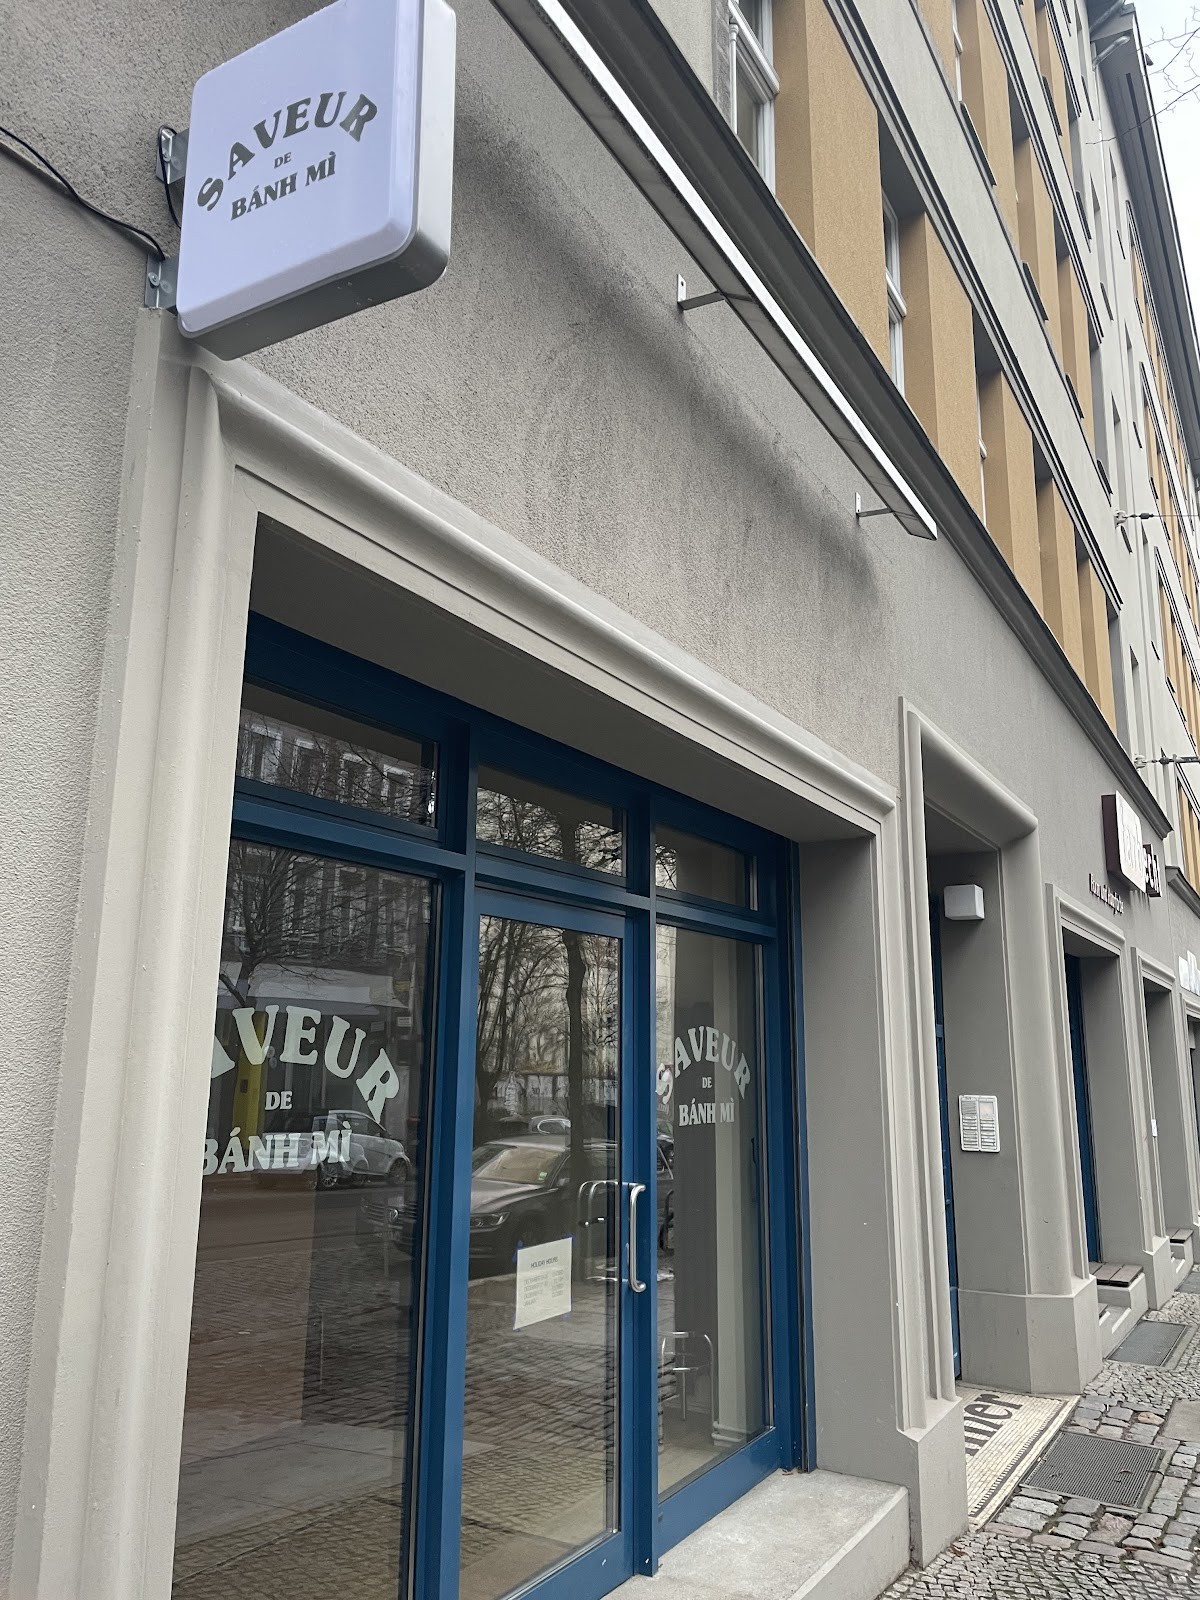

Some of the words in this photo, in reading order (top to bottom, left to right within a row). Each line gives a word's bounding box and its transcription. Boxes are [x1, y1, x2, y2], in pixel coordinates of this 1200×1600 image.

[197, 91, 377, 211] SAVEUR
[274, 152, 292, 169] DE
[230, 172, 298, 221] BÁNH
[305, 151, 336, 187] MÌ
[656, 1026, 751, 1104] SAVEUR
[702, 1077, 712, 1089] DE
[265, 1090, 293, 1110] DE
[679, 1098, 716, 1126] BÁNH
[720, 1097, 735, 1123] MÌ
[310, 1121, 352, 1164] MÌ
